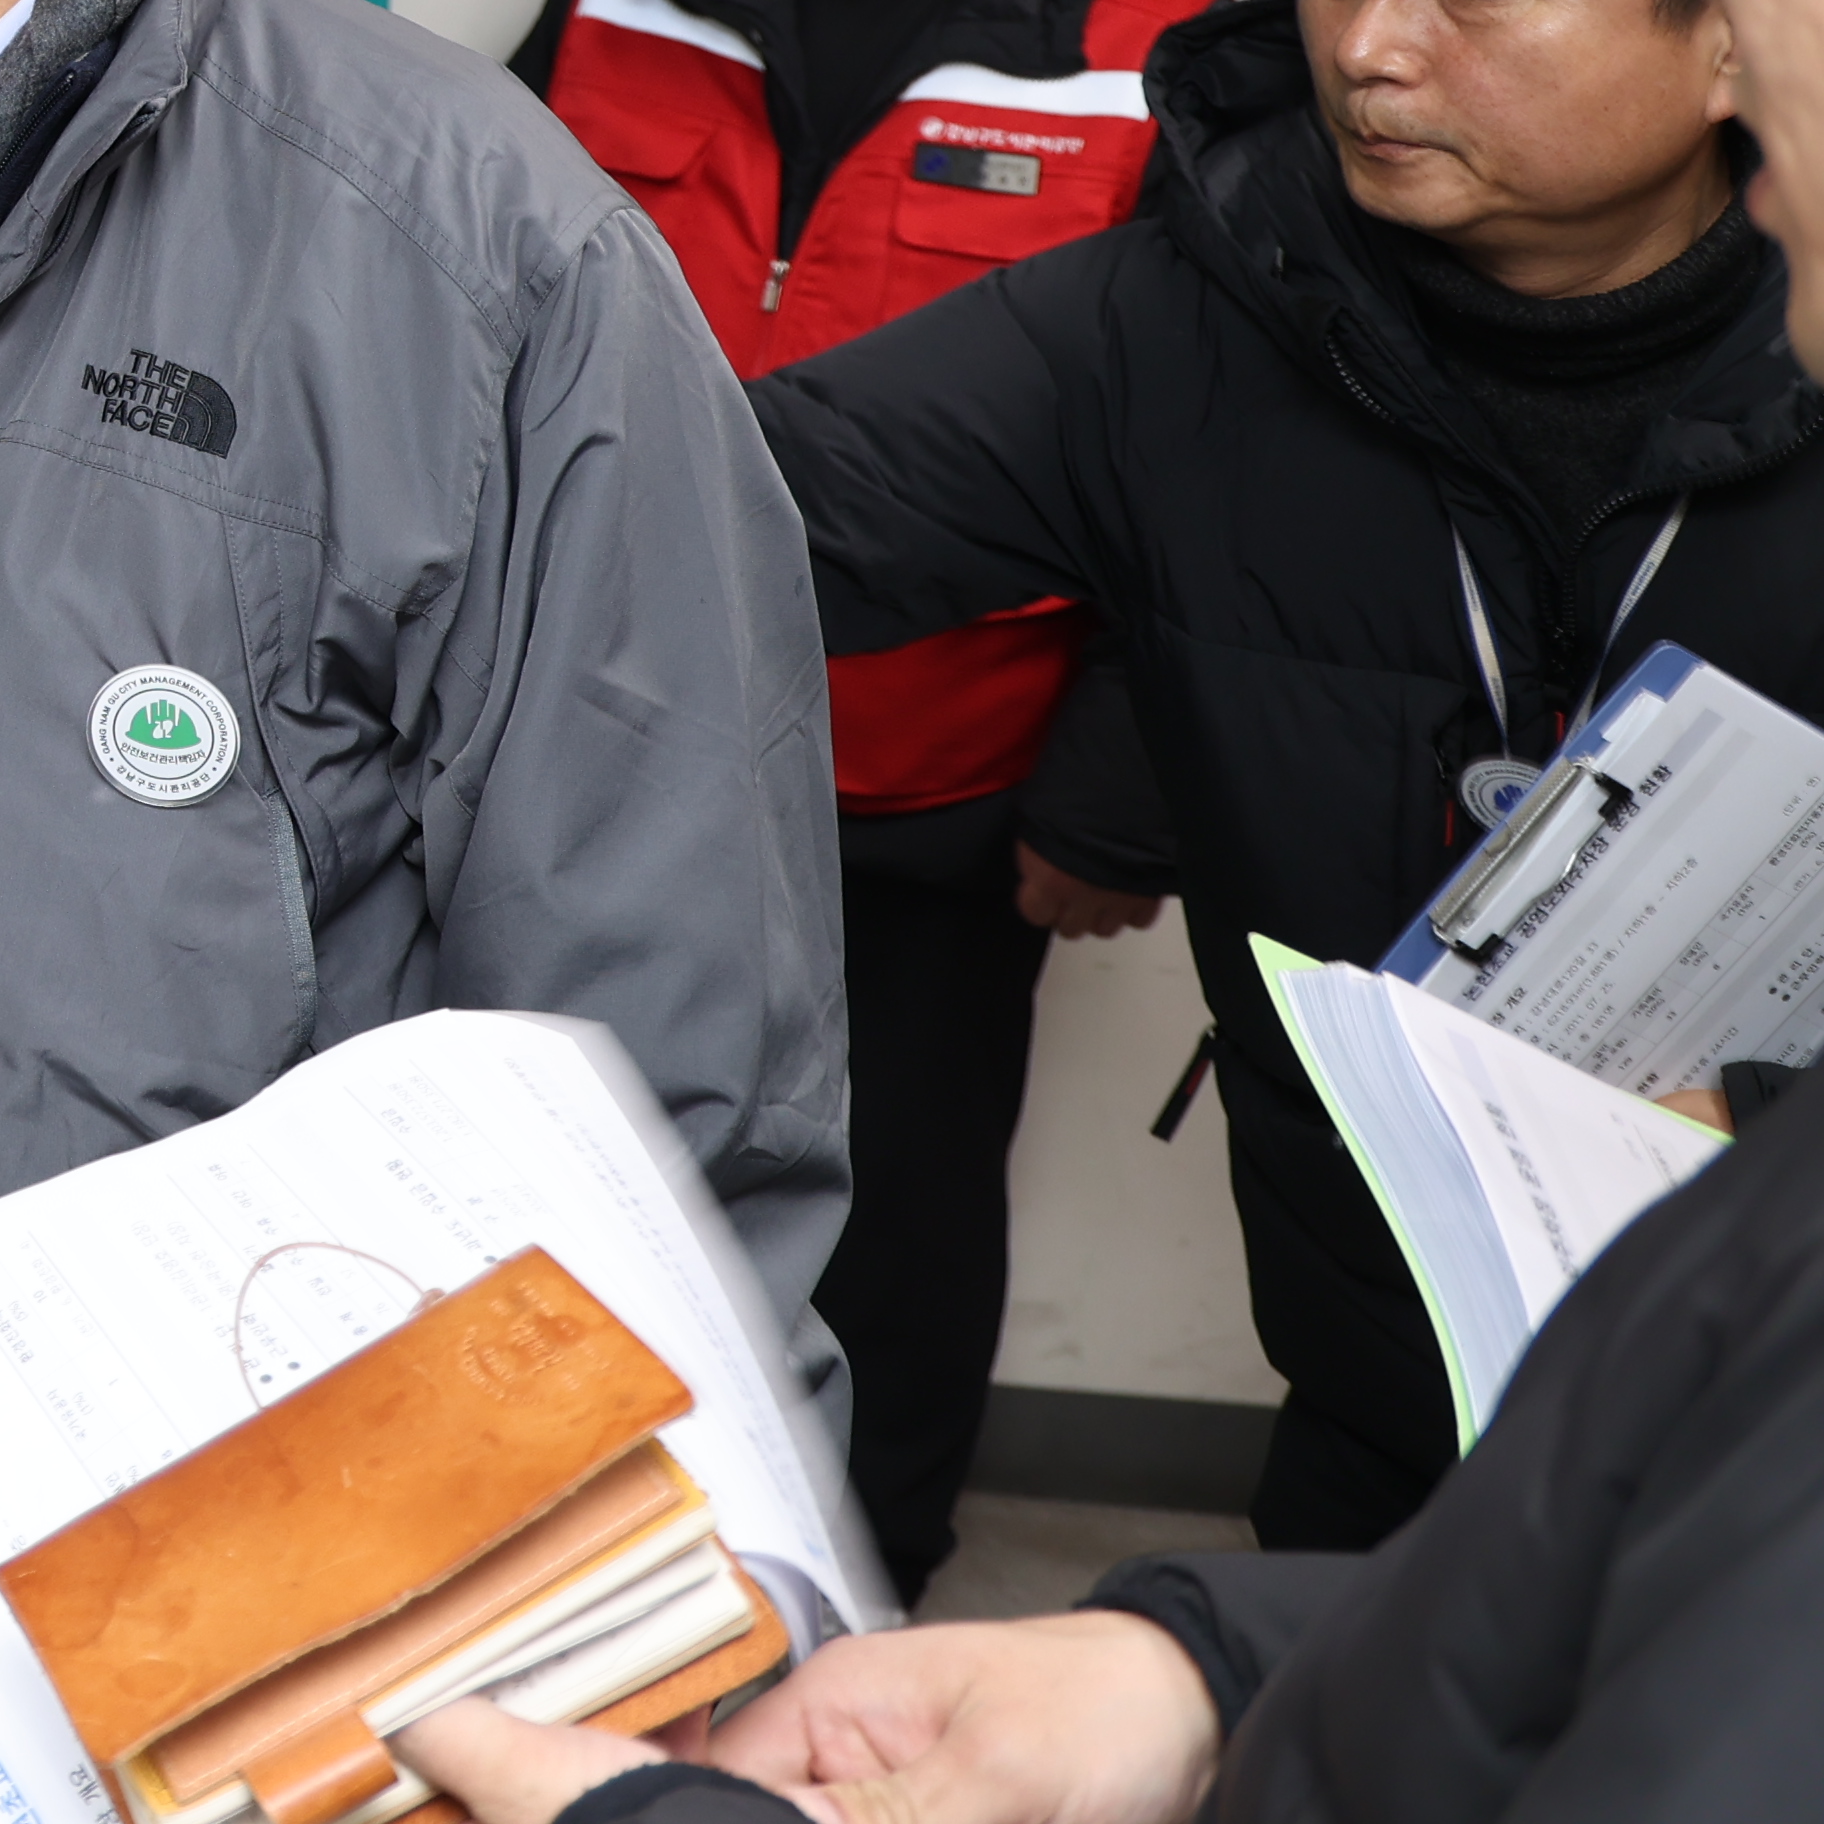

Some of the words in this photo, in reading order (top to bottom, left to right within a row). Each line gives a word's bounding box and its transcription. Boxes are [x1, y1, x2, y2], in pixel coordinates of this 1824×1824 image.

[130, 348, 190, 391] THE
[81, 363, 185, 414] NORTH
[101, 398, 176, 440] FACE
[108, 692, 120, 705] GU
[119, 679, 138, 694] CITY
[139, 676, 207, 701] MANAGEMENT
[99, 705, 111, 725] NAM
[99, 728, 111, 755] GANG
[205, 699, 229, 765] CORPORATION
[120, 742, 206, 766] 안전보건관리책임자
[116, 764, 212, 794] 강남구도시관리공단
[1637, 760, 1673, 799] 현황
[1798, 829, 1817, 848] (5%)
[1622, 903, 1657, 940] 지하1층
[1663, 855, 1699, 892] 지하2층
[1529, 953, 1587, 1018] 강남대로120길
[1584, 939, 1600, 956] 33
[1503, 984, 1528, 1011] 개요
[1707, 1024, 1740, 1056] 24시간
[378, 1105, 413, 1137] 수입금
[383, 1155, 414, 1183] 현황
[407, 1179, 449, 1218] 수입금
[442, 1215, 484, 1256] 과년도
[6, 1299, 29, 1323] (5%)
[32, 1287, 49, 1304] 10
[239, 1309, 289, 1360] 근무인력
[43, 1387, 89, 1443] 국가유공자
[71, 1389, 96, 1416] (1%)
[65, 1761, 105, 1805] 개요
